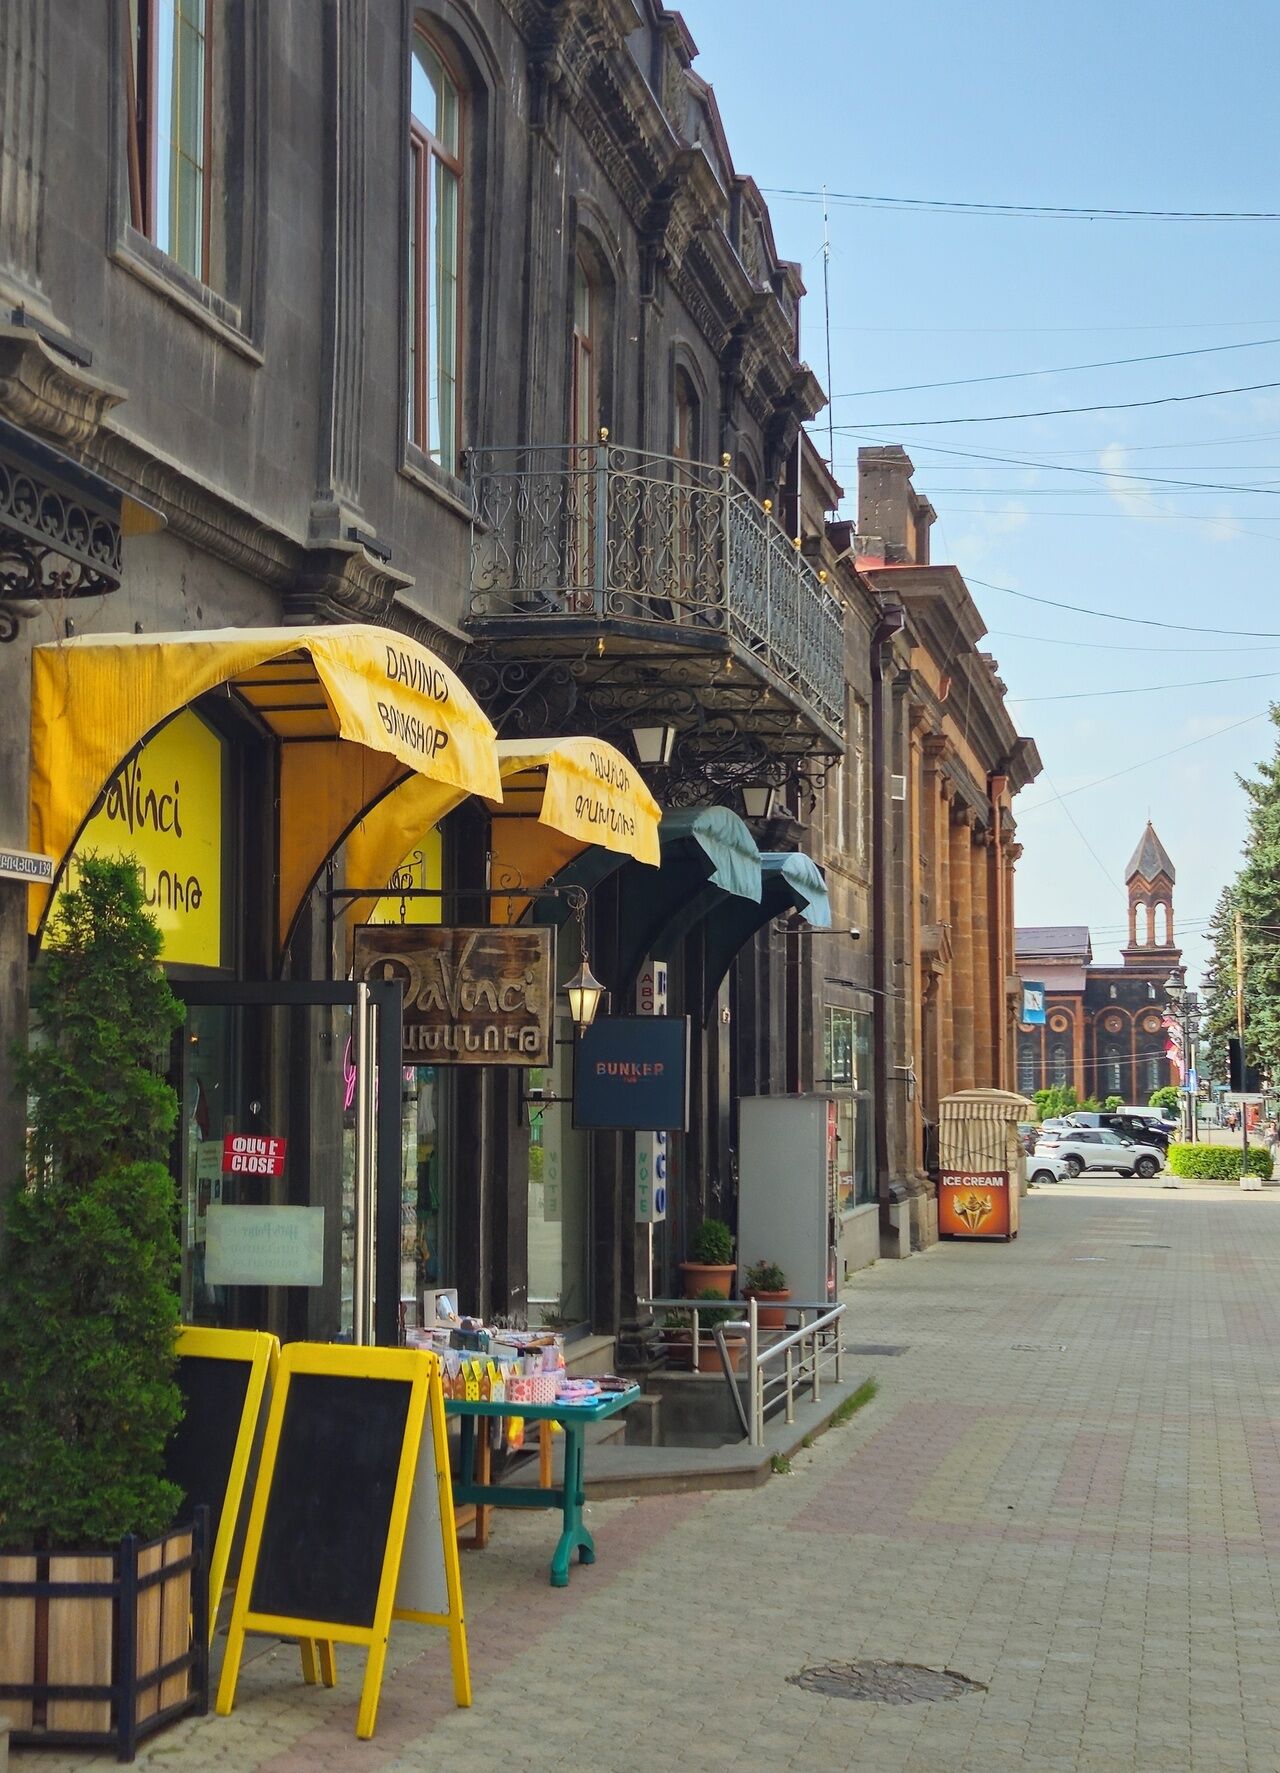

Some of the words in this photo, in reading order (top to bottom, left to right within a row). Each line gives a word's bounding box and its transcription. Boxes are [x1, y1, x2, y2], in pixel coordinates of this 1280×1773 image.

[386, 645, 449, 703] DAVINCI
[377, 702, 449, 759] BOOKSHOP
[90, 750, 182, 838] aVinci
[38, 861, 51, 876] 139
[402, 1024, 541, 1053] ԱԽԱՆՈՒԹ
[596, 1062, 664, 1076] BUNKER
[233, 1136, 266, 1155] ՓԱԿ
[269, 1140, 278, 1156] Է
[231, 1155, 275, 1174] CLOSE
[943, 1176, 962, 1187] ICE
[963, 1176, 1004, 1187] CREAM
